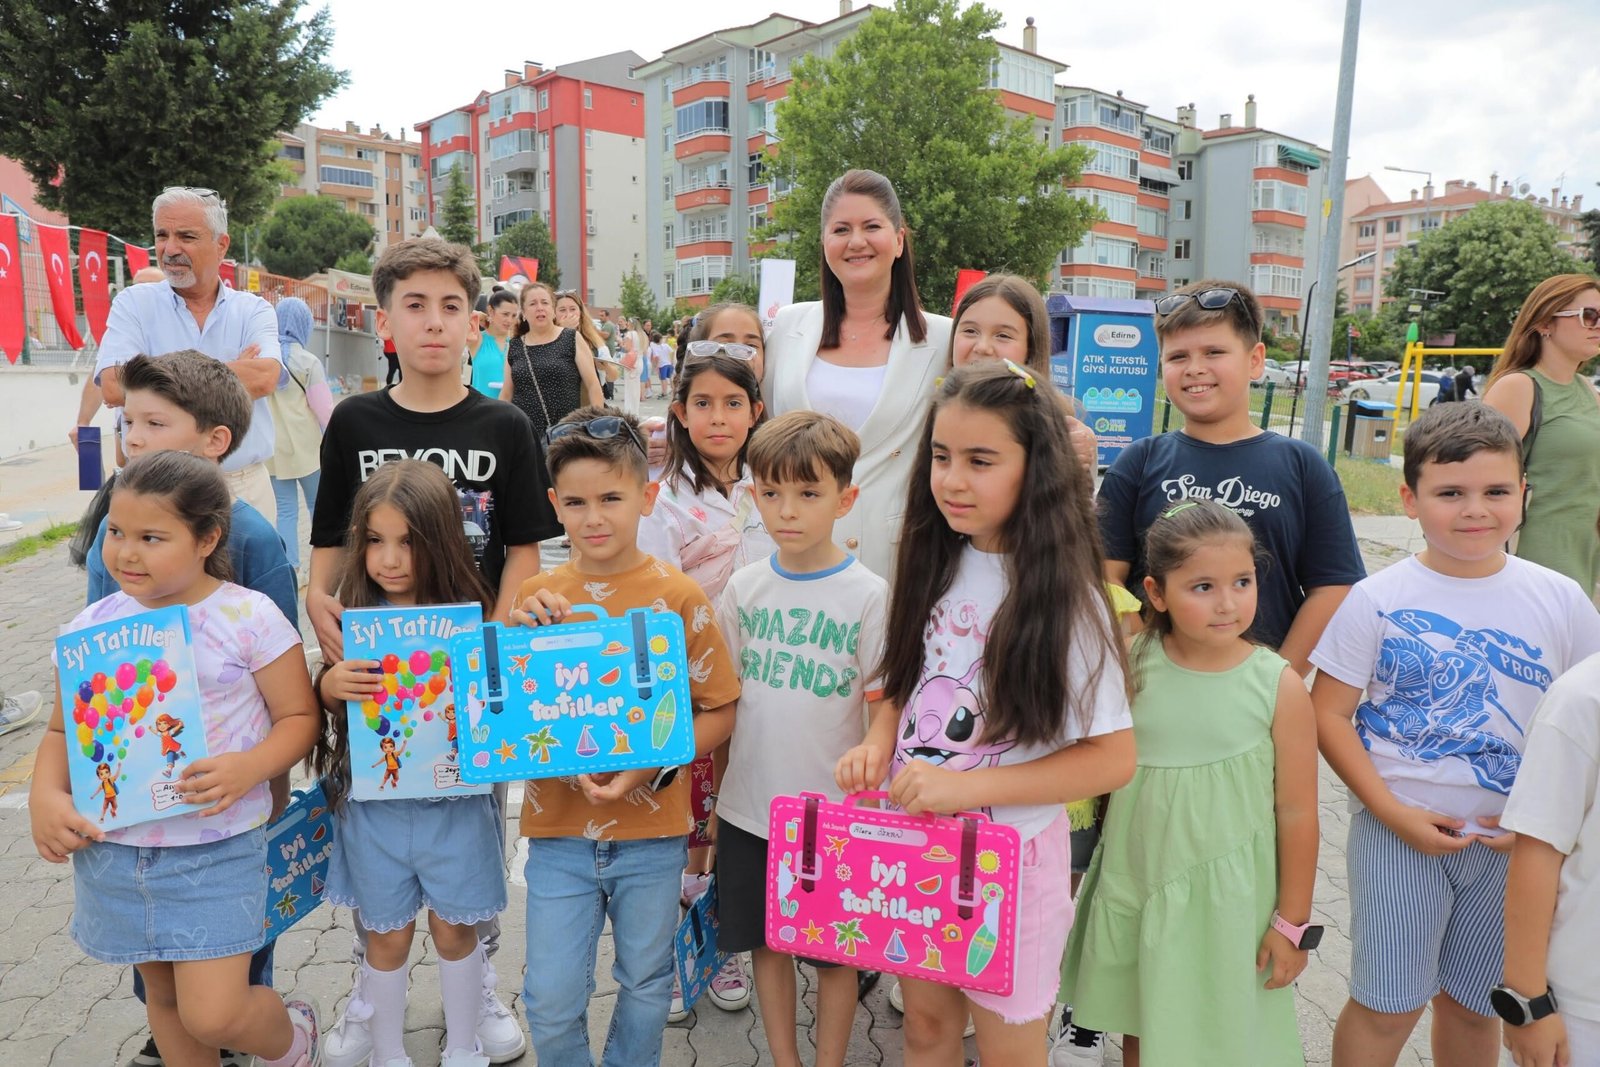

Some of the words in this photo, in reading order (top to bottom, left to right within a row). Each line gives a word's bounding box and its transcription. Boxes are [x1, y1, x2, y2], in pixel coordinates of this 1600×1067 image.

[1111, 331, 1136, 339] Edirne
[1082, 364, 1107, 374] GİYSİ
[1109, 366, 1148, 375] KUTUSU
[1083, 355, 1104, 363] ATIK
[1110, 355, 1148, 365] TEKSTİL
[1161, 474, 1212, 502] San
[1213, 476, 1281, 510] Diego
[93, 622, 176, 655] Tatiller
[388, 614, 477, 640] Tatille
[555, 662, 589, 690] iyi
[1500, 653, 1549, 688] PRORS
[528, 691, 625, 722] tatiller
[280, 833, 306, 861] iyi
[270, 841, 334, 893] tatiller
[870, 855, 907, 888] iyi
[839, 887, 942, 928] tatiller
